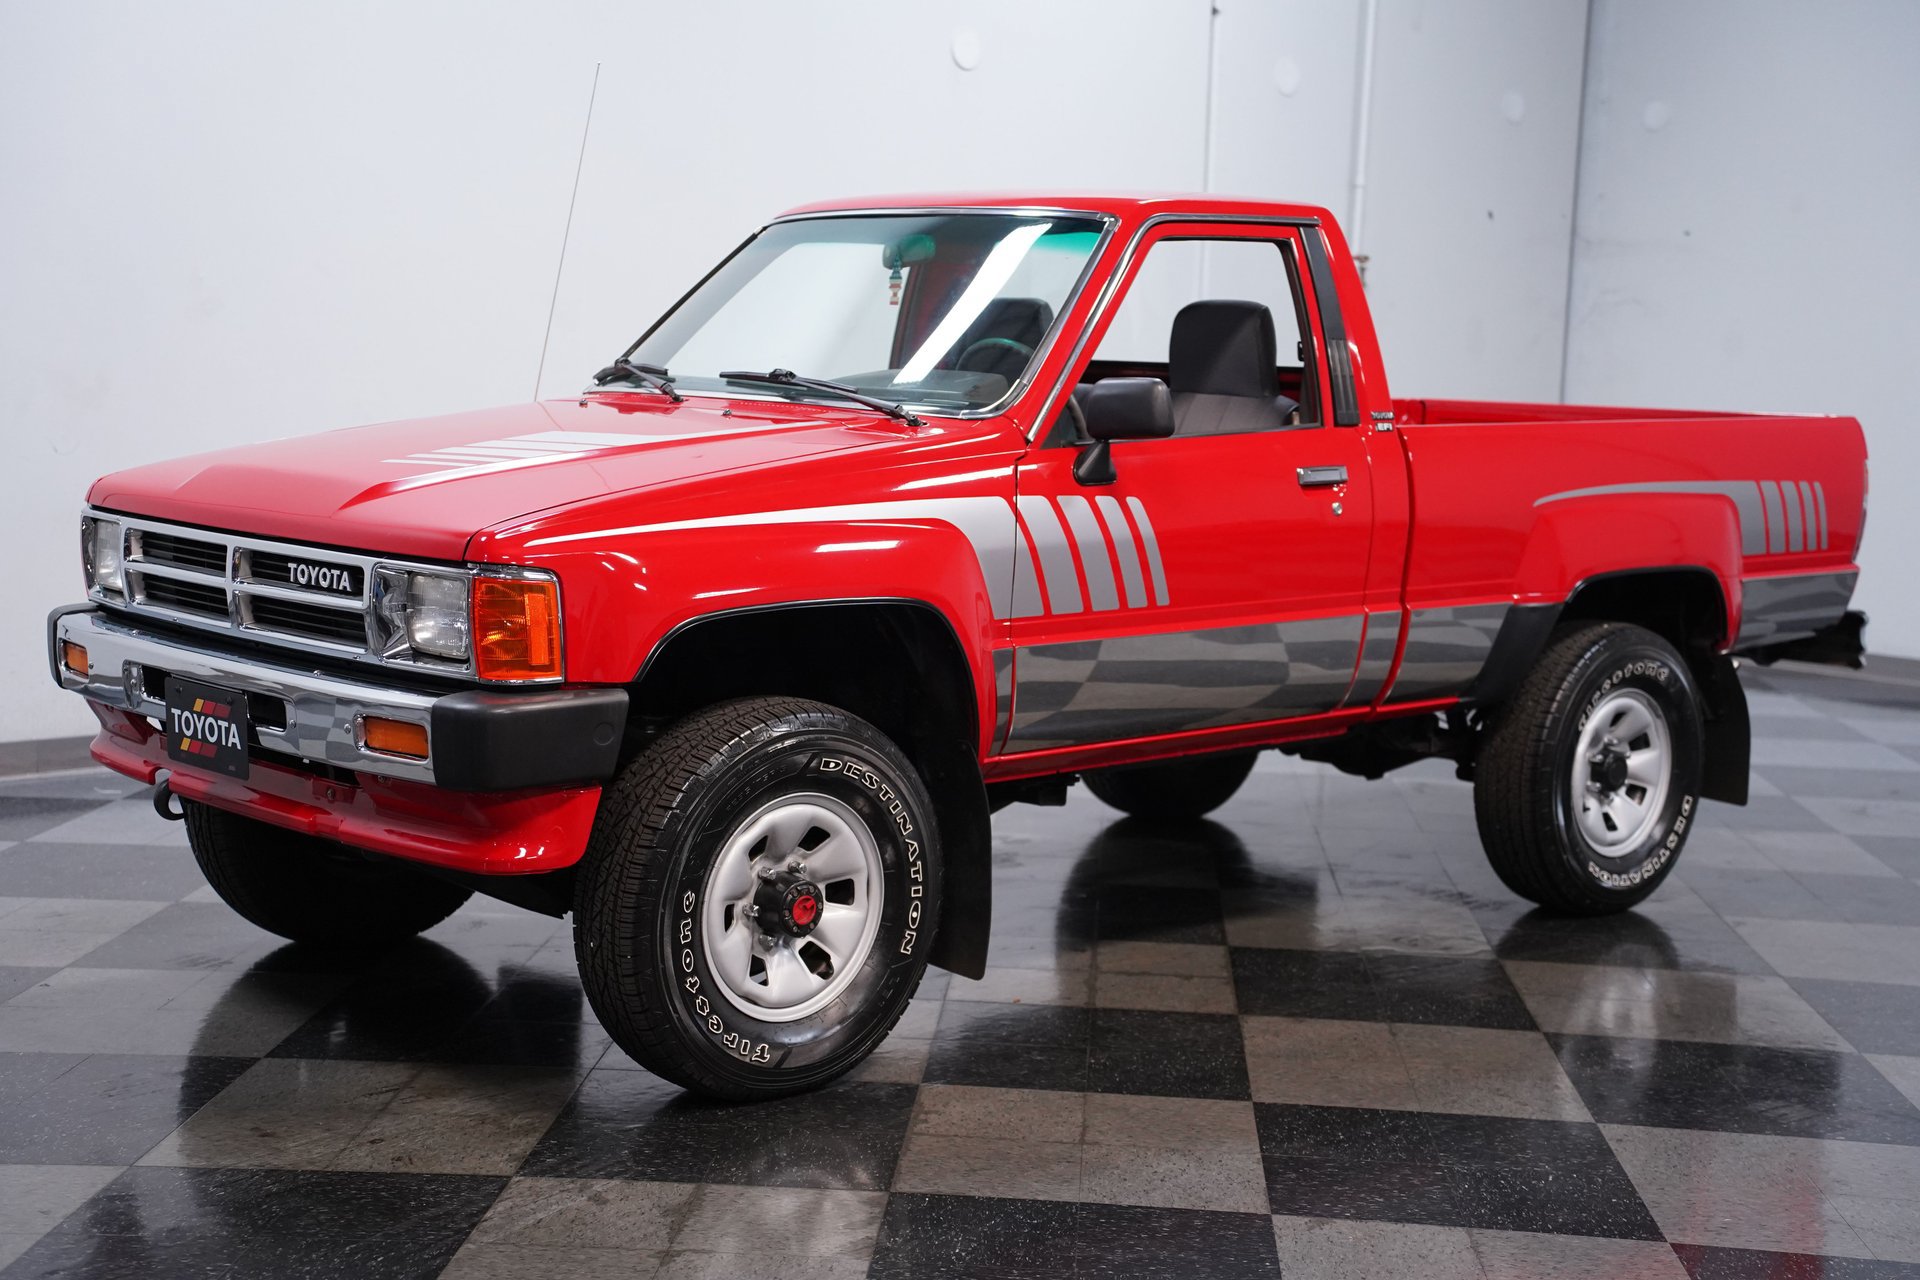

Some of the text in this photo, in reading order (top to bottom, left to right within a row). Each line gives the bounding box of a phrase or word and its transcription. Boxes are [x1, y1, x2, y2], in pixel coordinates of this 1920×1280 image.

[288, 563, 352, 591] TOYOTA
[171, 708, 242, 750] TOYOTA
[819, 757, 923, 955] DESTINATION
[1588, 796, 1693, 888] DESTINATION
[680, 890, 770, 1063] Firestone
